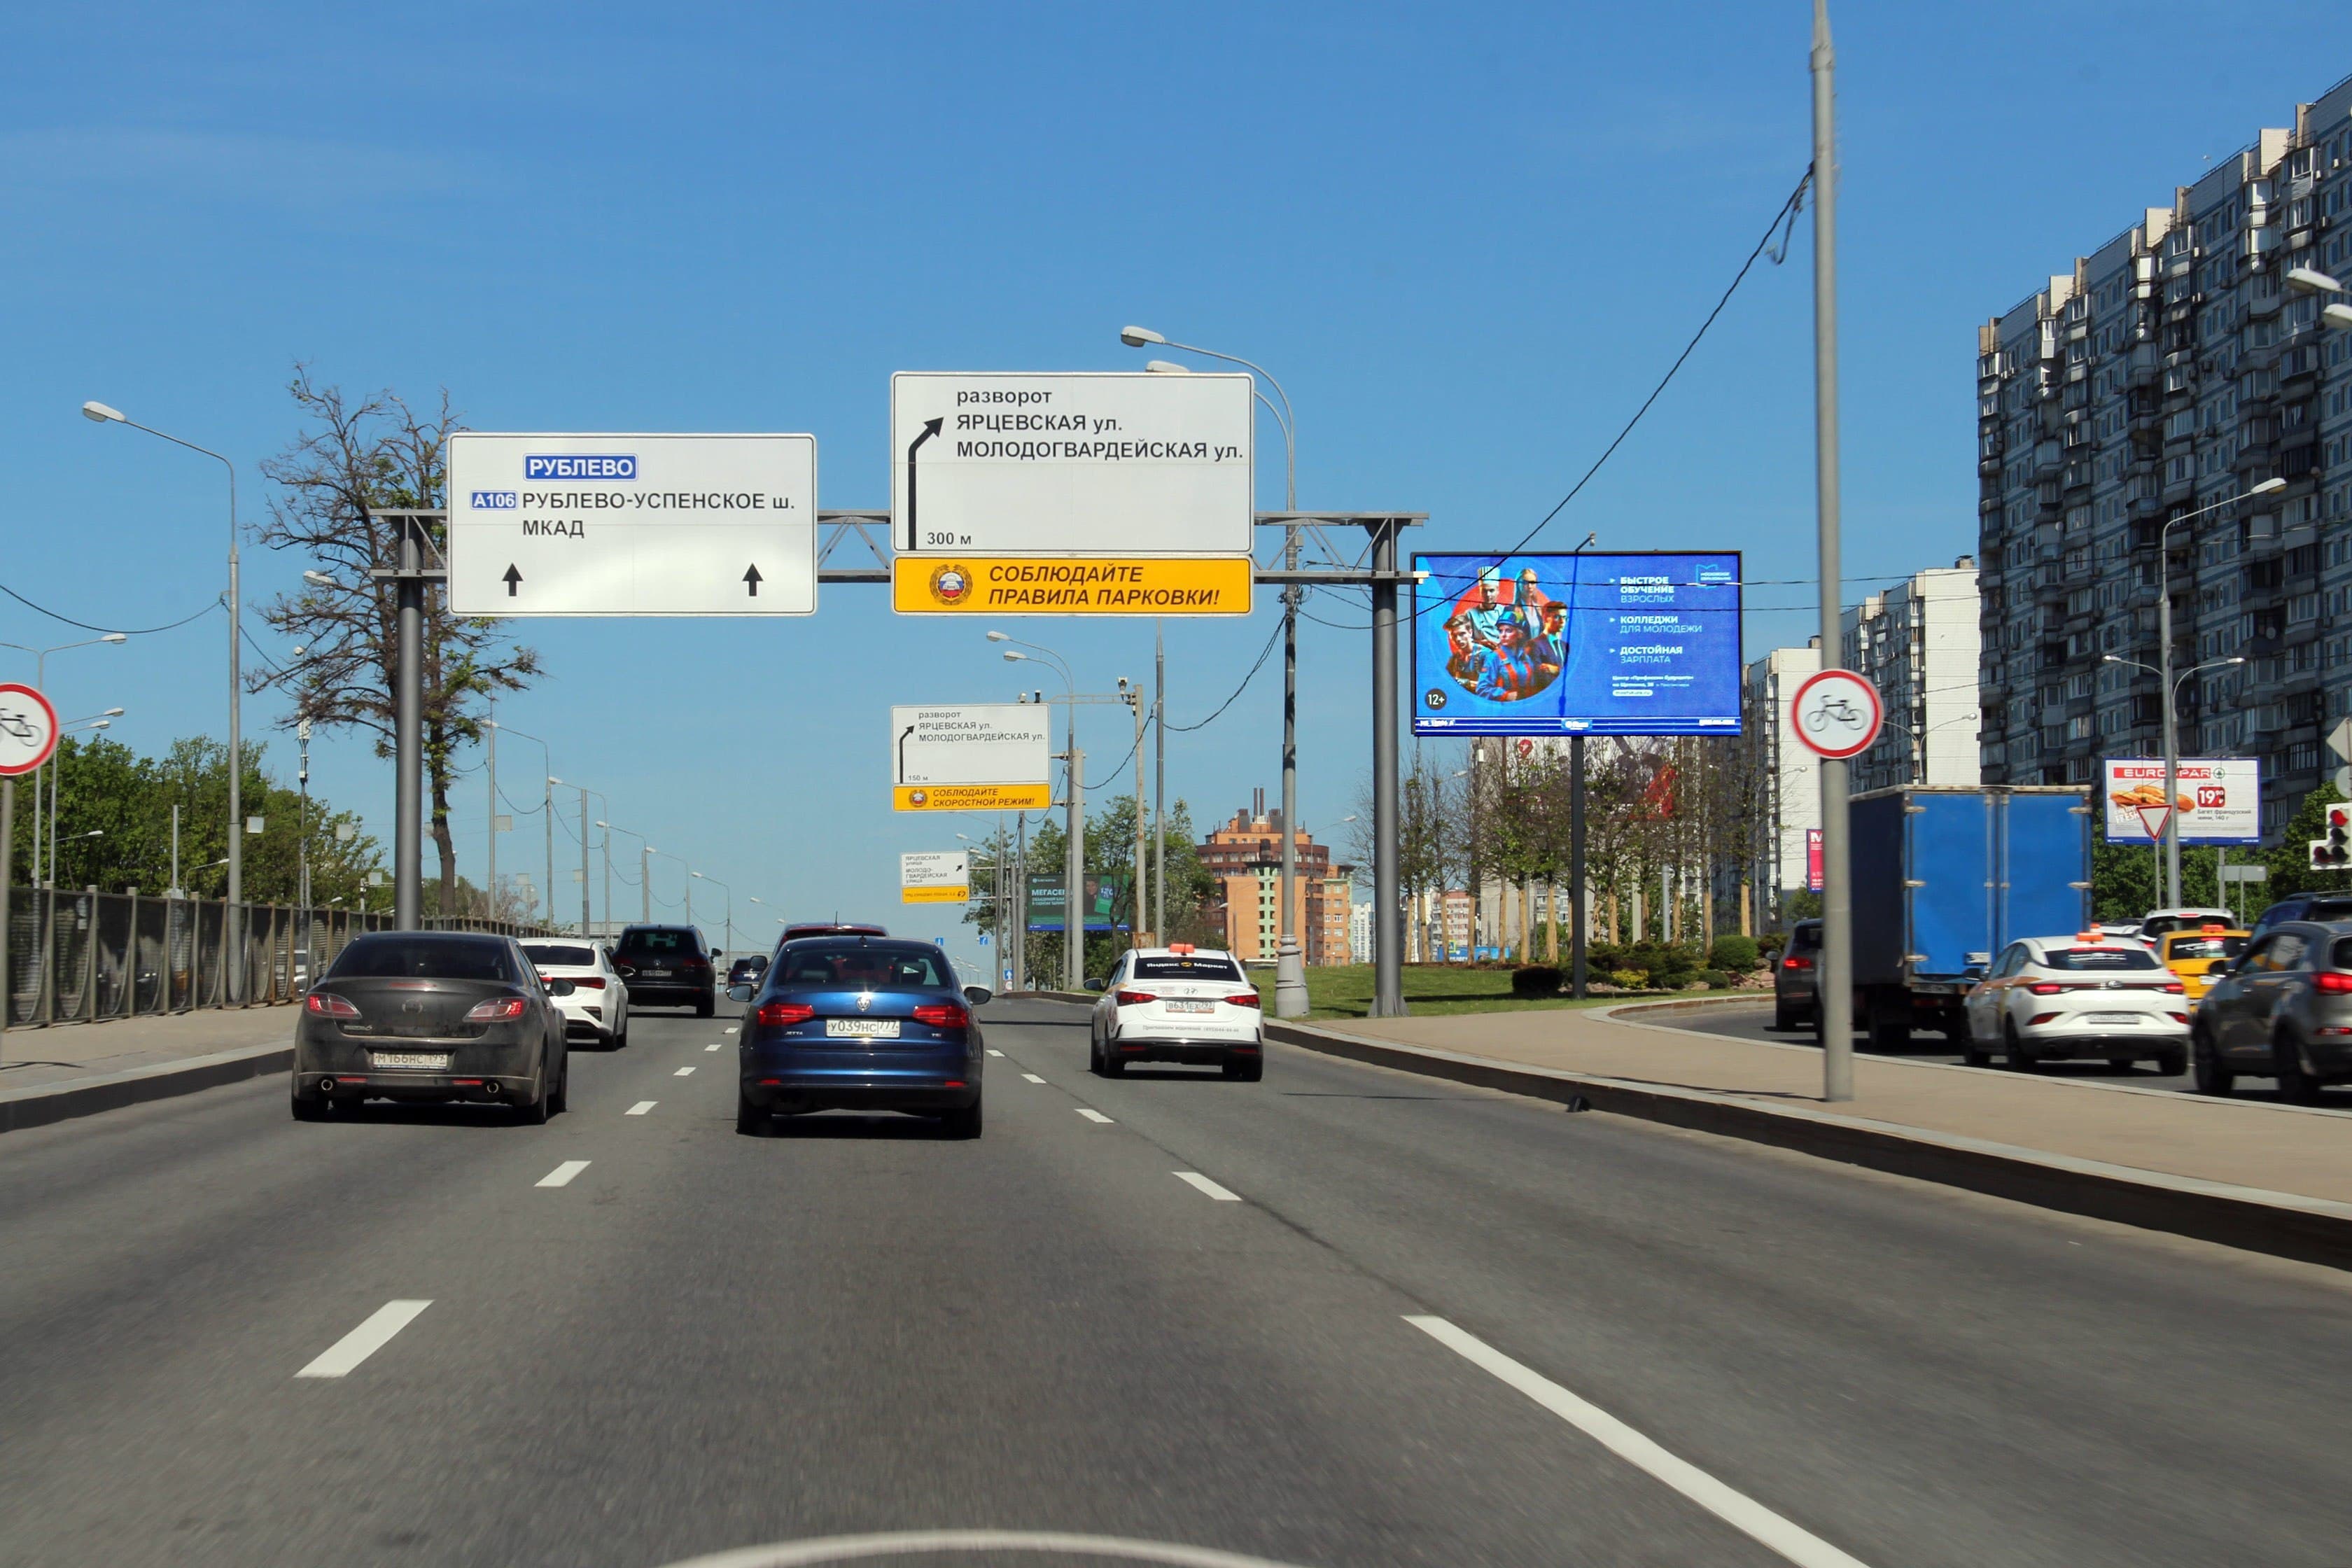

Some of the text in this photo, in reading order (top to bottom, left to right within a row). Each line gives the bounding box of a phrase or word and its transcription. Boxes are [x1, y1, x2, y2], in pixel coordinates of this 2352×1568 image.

[957, 389, 1052, 405] разворот
[957, 414, 1122, 434] ЯРЦЕВСКАЯ ул.
[957, 438, 1243, 461] МОЛОДОГВАРДЕЙСКАЯ ул.
[530, 458, 633, 476] РУБЛЕВО
[474, 493, 514, 507] А106
[523, 493, 794, 509] РУБЛЕВО-УСПЕНСКОЕ ш.
[523, 520, 584, 538] МКАД
[927, 532, 972, 545] 300 м
[989, 564, 1144, 584] СОБЛЮДАЙТЕ
[1620, 576, 1670, 584] БЫСТРОЕ
[1620, 585, 1675, 594] ОБУЧЕНИЕ
[988, 589, 1220, 606] ПРАВИЛА ПАРКОВКИ!
[1620, 595, 1675, 603] ВЗРОСЛЫХ
[1620, 615, 1679, 625] КОЛЛЕДЖИ
[1620, 624, 1702, 634] ДЛЯ МОЛОДЕЖИ
[1619, 645, 1684, 656] ДОСТОЙНАЯ
[1620, 655, 1672, 664] ЗАРПЛАТА
[1427, 693, 1446, 706] 12+
[918, 711, 962, 720] разворот
[918, 722, 976, 732] ЯРЦЕВСКАЯ
[918, 732, 1029, 742] МОЛОДОГВАРДЕЙСКАЯ
[2124, 769, 2209, 777] EUROPAR
[933, 788, 998, 797] СОБЛЮДАЙТЕ
[2199, 790, 2216, 804] 19
[933, 798, 1035, 807] СКОРОСТНОЙ РЕЖИМ!
[831, 1020, 877, 1032] У039НС
